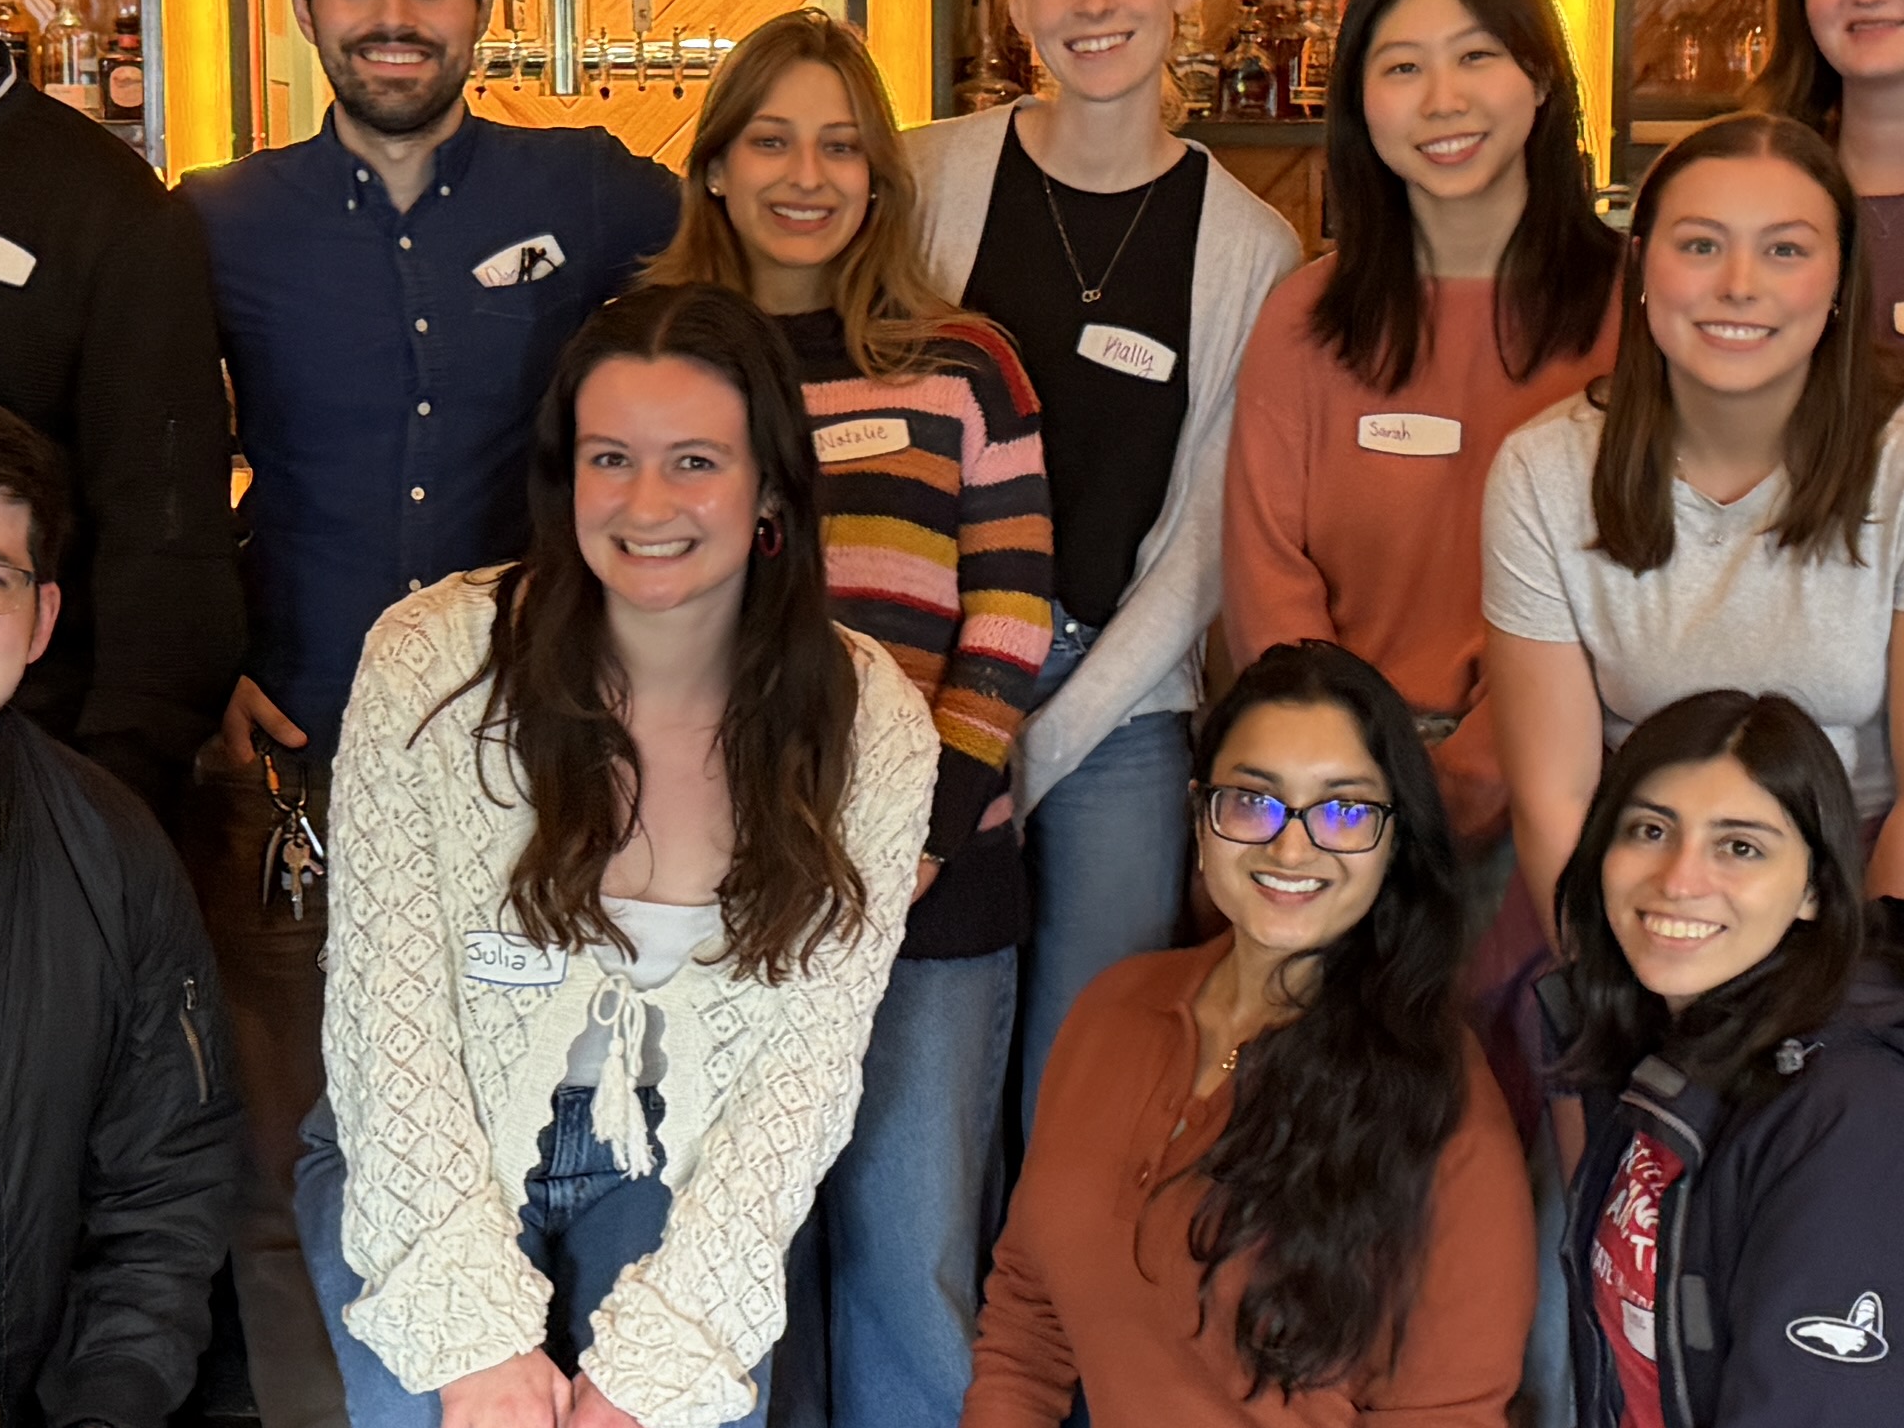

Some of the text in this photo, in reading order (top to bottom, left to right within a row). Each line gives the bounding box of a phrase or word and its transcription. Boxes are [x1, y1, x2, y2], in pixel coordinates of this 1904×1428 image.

[816, 424, 888, 453] Natalie
[1368, 418, 1411, 441] Sarah
[464, 942, 527, 971] Julia
